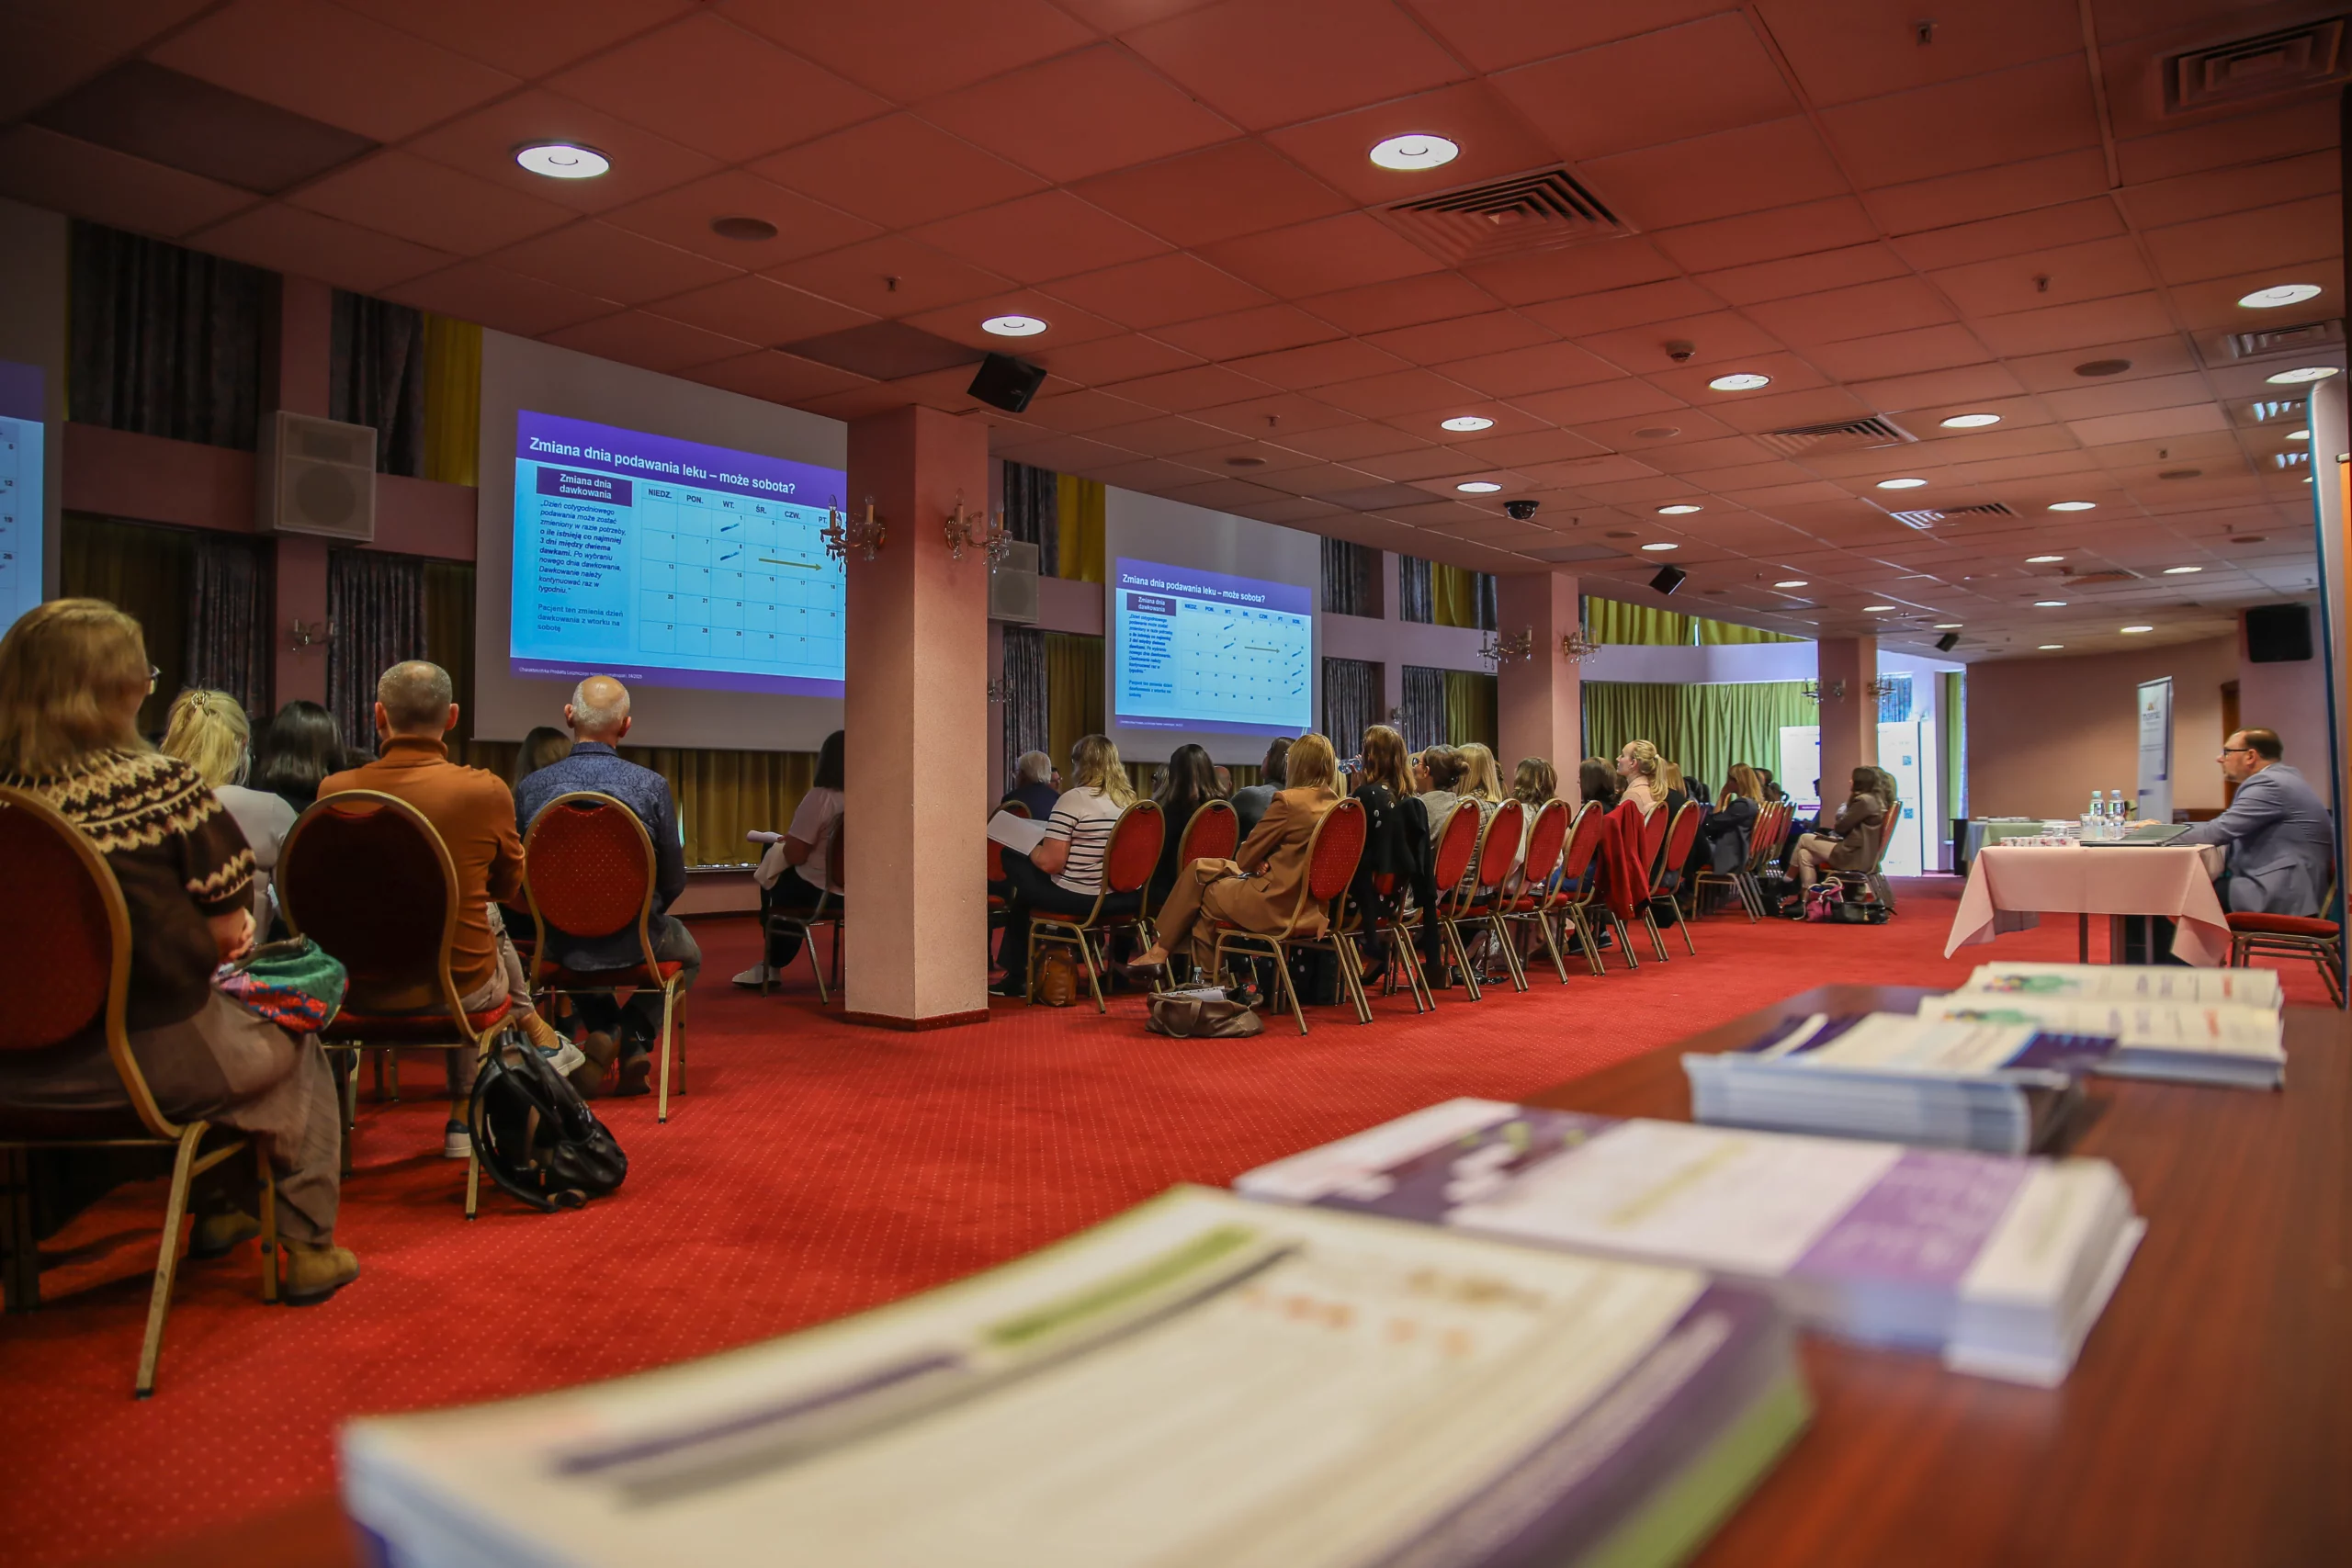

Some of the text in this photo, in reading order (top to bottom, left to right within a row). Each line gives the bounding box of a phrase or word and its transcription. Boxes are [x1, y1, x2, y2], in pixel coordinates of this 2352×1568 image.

[529, 436, 580, 457] Zmiana
[584, 446, 611, 462] dnia
[614, 452, 680, 475] podawania
[683, 463, 707, 479] leku
[719, 471, 749, 488] może
[752, 477, 796, 494] sobota?
[560, 473, 612, 489] Zmiana dnia
[560, 485, 612, 500] dawkowania
[648, 489, 672, 499] NIEDZ.
[686, 494, 704, 504] PON.
[722, 500, 734, 509] WT.
[563, 502, 615, 515] cotygodniowego
[756, 505, 767, 514] ŚR.
[540, 510, 617, 525] podawania może zostać
[785, 511, 800, 520] CZW.
[540, 519, 573, 529] zmieniony
[547, 528, 555, 536] ile
[557, 530, 582, 540] istnieją
[594, 535, 622, 545] najmniej
[546, 537, 557, 546] dni
[558, 539, 583, 549] między
[584, 542, 611, 551] dwiema
[539, 547, 572, 557] dawkami.
[584, 552, 613, 561] wybraniu
[539, 557, 564, 566] nowego
[538, 566, 602, 580] Dawkowanie należy
[538, 576, 581, 587] kontynuować
[1123, 574, 1148, 586] Zmiana
[1149, 579, 1164, 588] dnia
[1166, 581, 1201, 594] podawania
[1203, 586, 1216, 596] leku
[1223, 590, 1239, 599] może
[1240, 592, 1265, 603] sobota?
[1138, 596, 1155, 604] Zmiana
[538, 604, 563, 614] Pacjent
[605, 609, 624, 617] dzień
[1138, 604, 1165, 613] dawkowania
[537, 614, 580, 624] dawkowania
[587, 617, 610, 626] wtorku
[537, 624, 560, 632] sobotę
